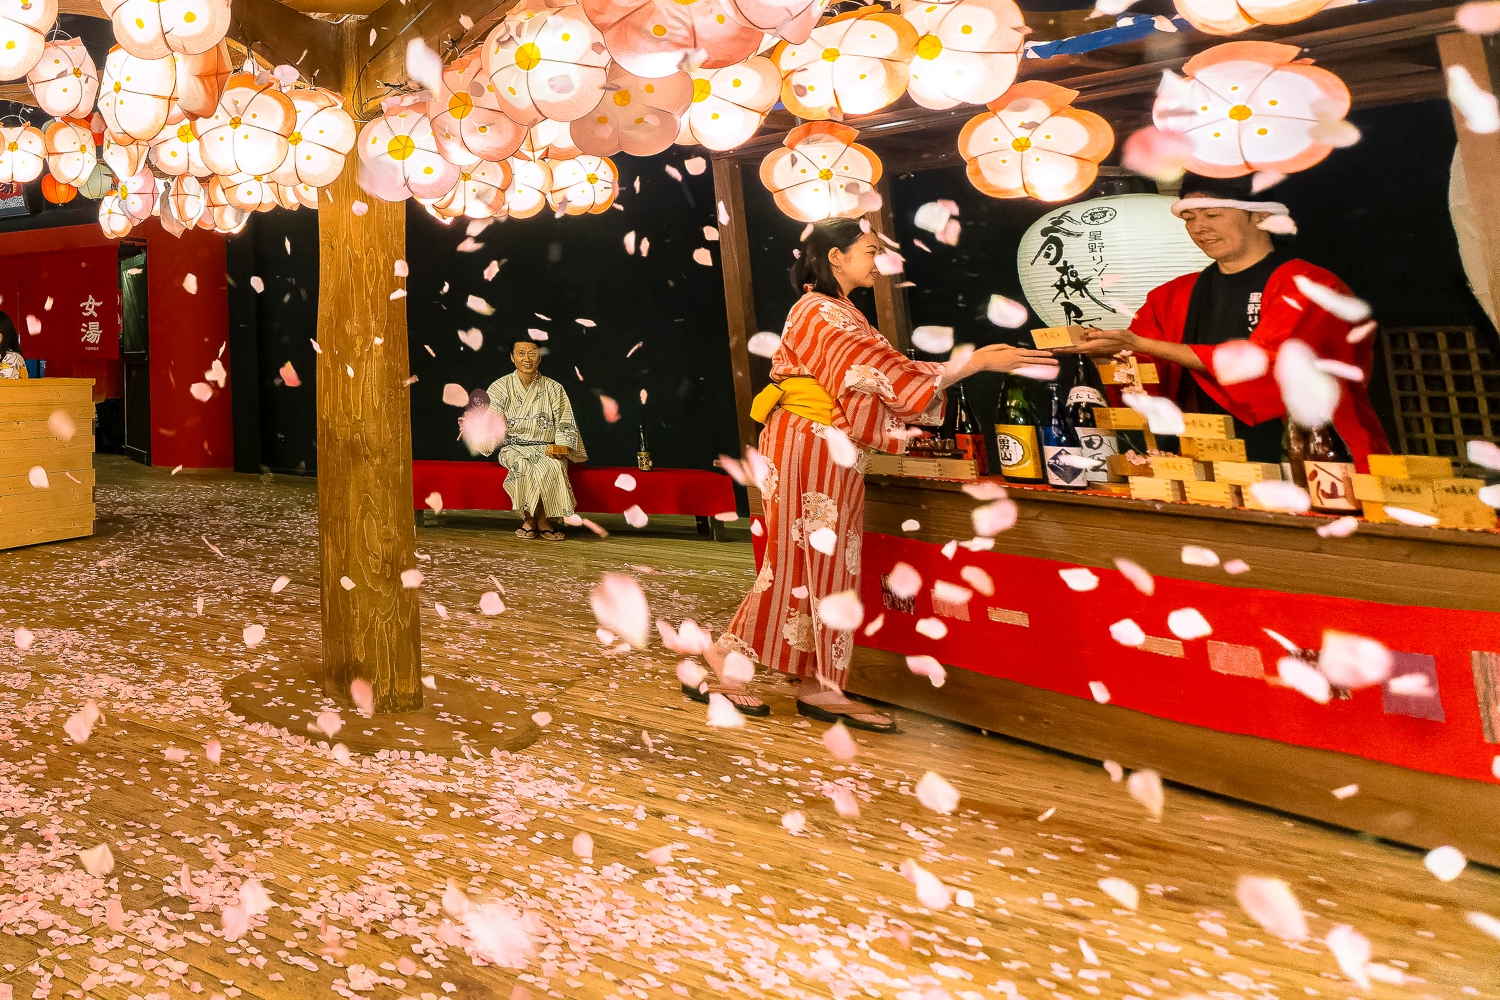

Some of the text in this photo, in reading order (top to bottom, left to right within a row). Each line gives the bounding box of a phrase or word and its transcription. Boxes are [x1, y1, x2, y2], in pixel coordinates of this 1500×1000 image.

[1088, 230, 1111, 296] 星野リゾト
[80, 295, 103, 344] 女湯
